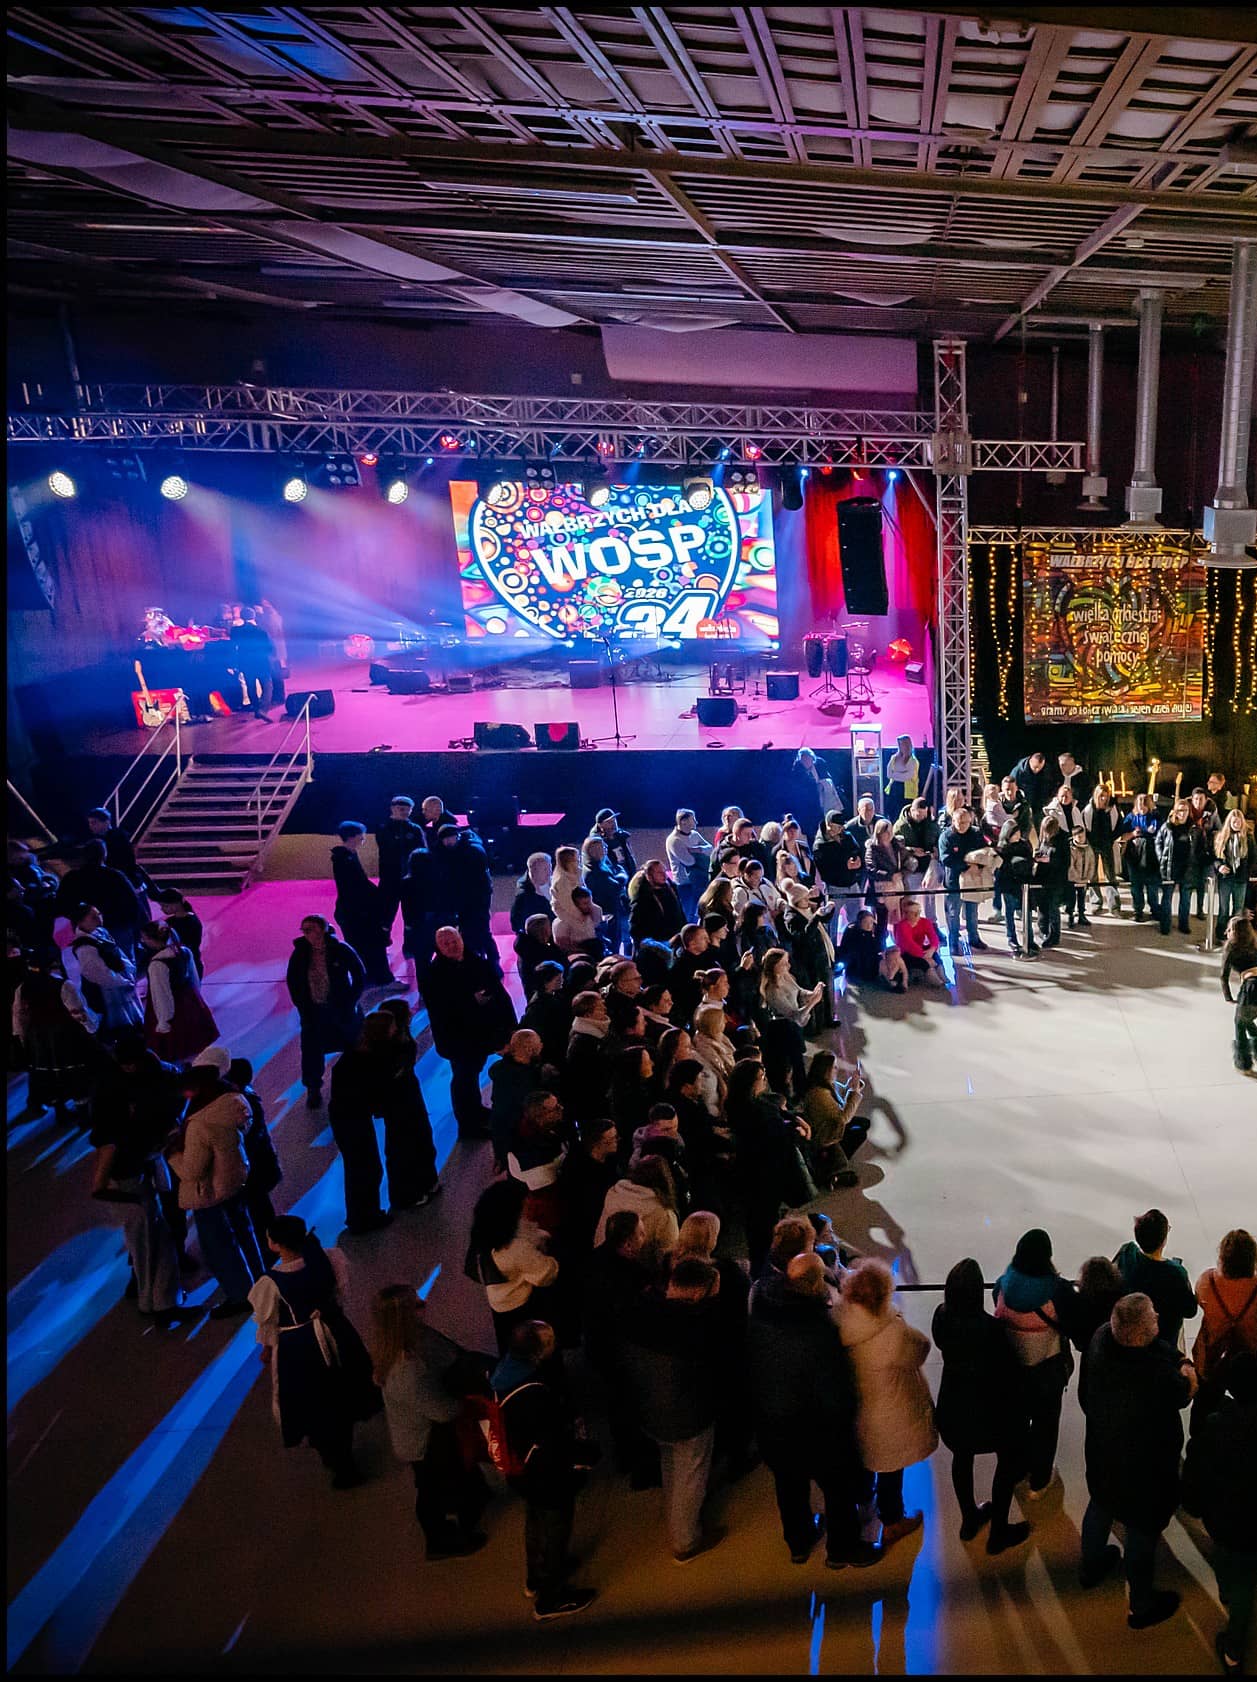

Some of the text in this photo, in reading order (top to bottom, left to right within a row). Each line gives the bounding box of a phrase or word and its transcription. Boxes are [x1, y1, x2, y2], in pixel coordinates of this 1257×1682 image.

[520, 499, 693, 539] WAŁBRZYCH DLA
[530, 521, 706, 587] WOŚP
[624, 588, 668, 599] 2026
[1072, 601, 1110, 622] wielka
[1096, 648, 1140, 670] pomocy
